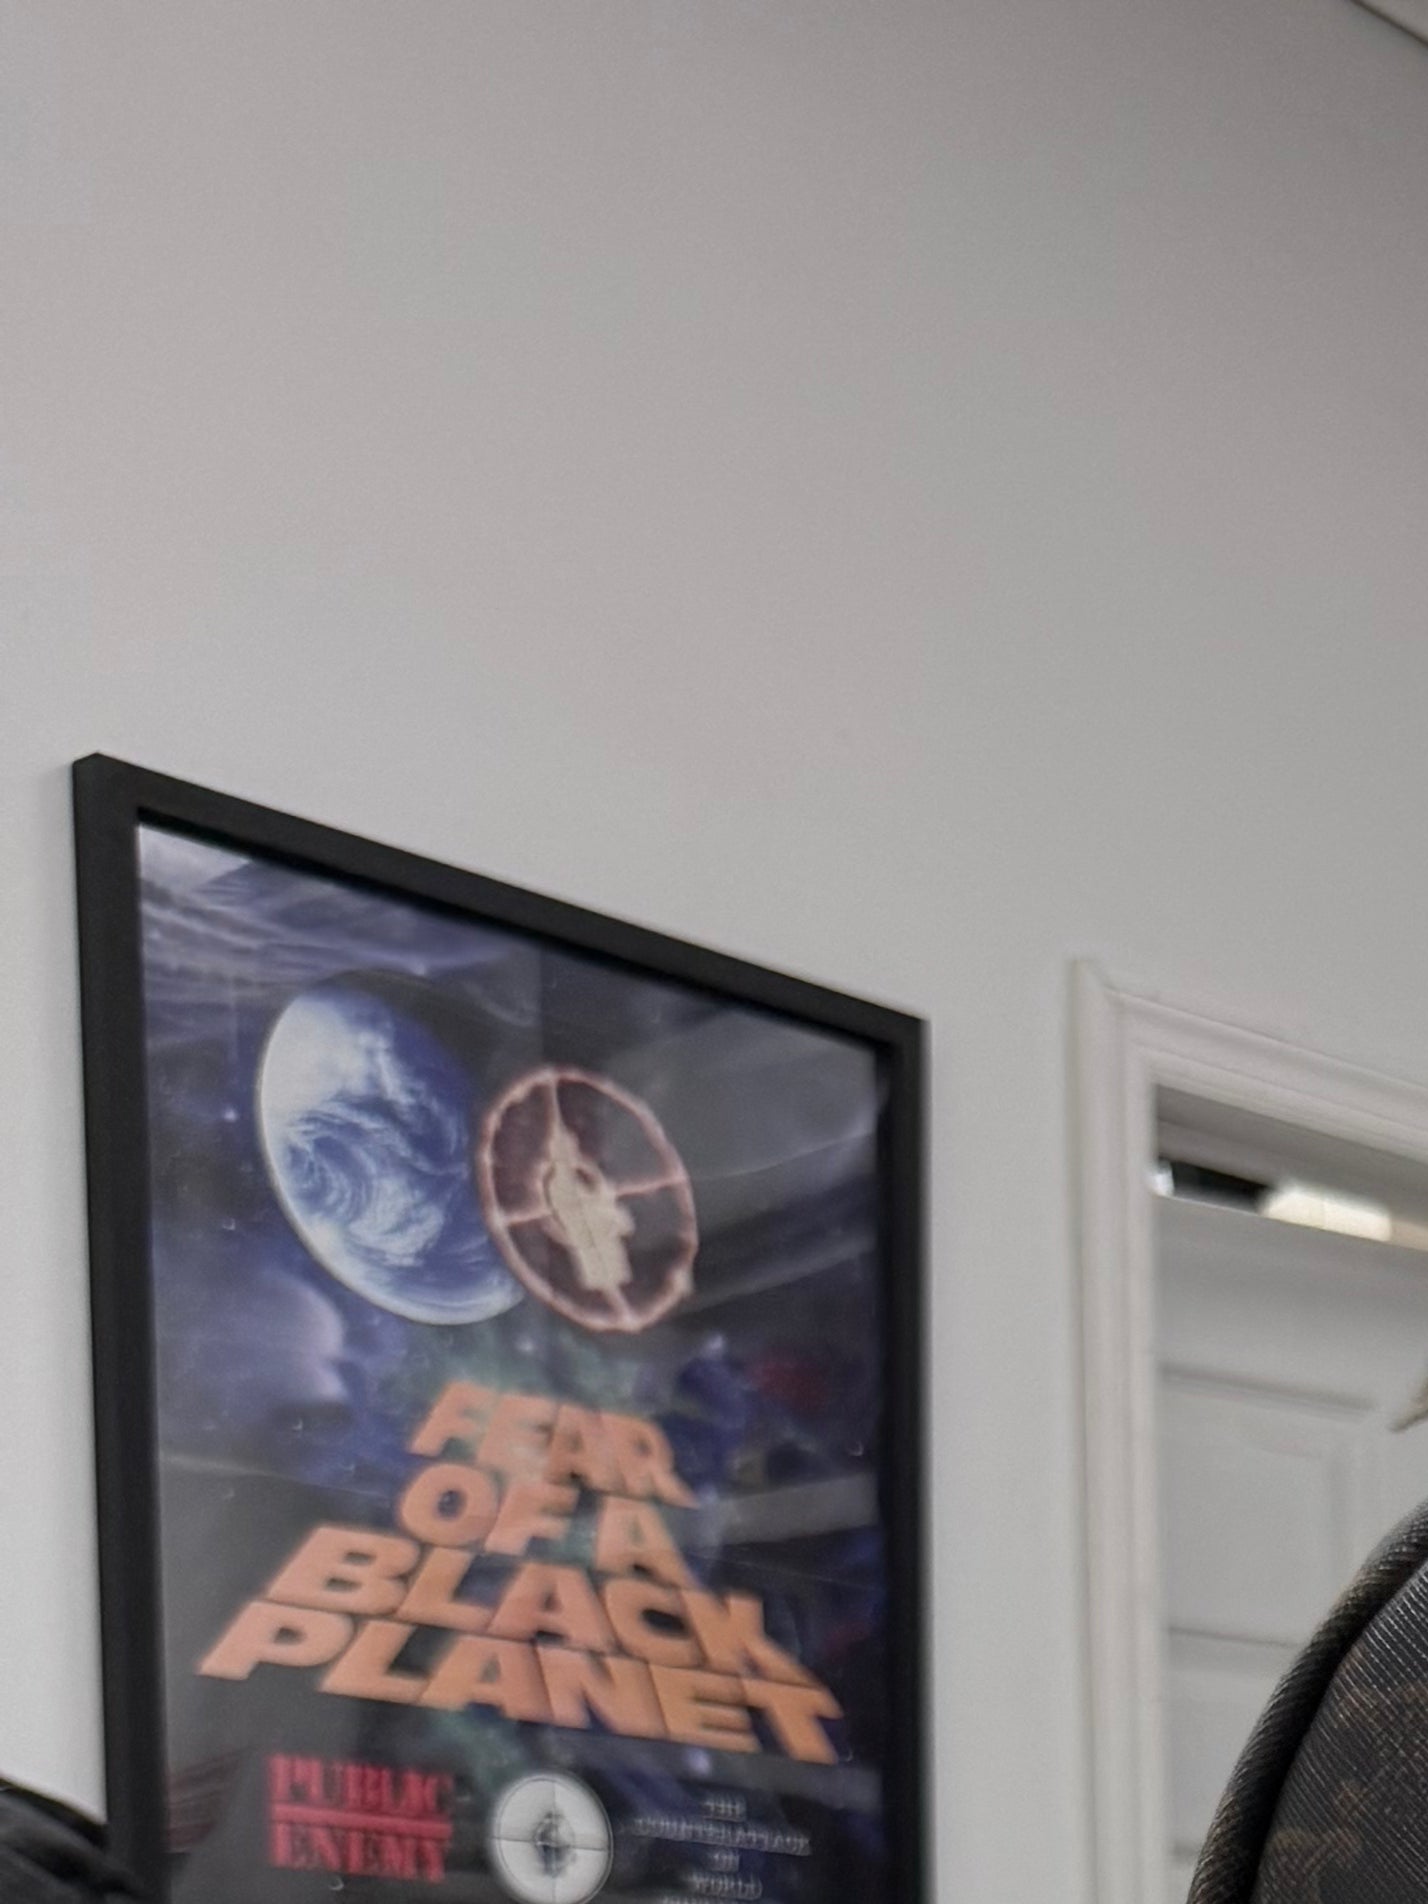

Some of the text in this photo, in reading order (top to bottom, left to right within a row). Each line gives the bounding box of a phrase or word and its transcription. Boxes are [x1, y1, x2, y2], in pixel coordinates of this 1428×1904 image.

[408, 1383, 700, 1508] FEAR
[401, 1463, 692, 1590] OF A
[266, 1526, 822, 1690] BLACK
[197, 1603, 843, 1765] PLANET
[269, 1818, 447, 1883] ENEMY
